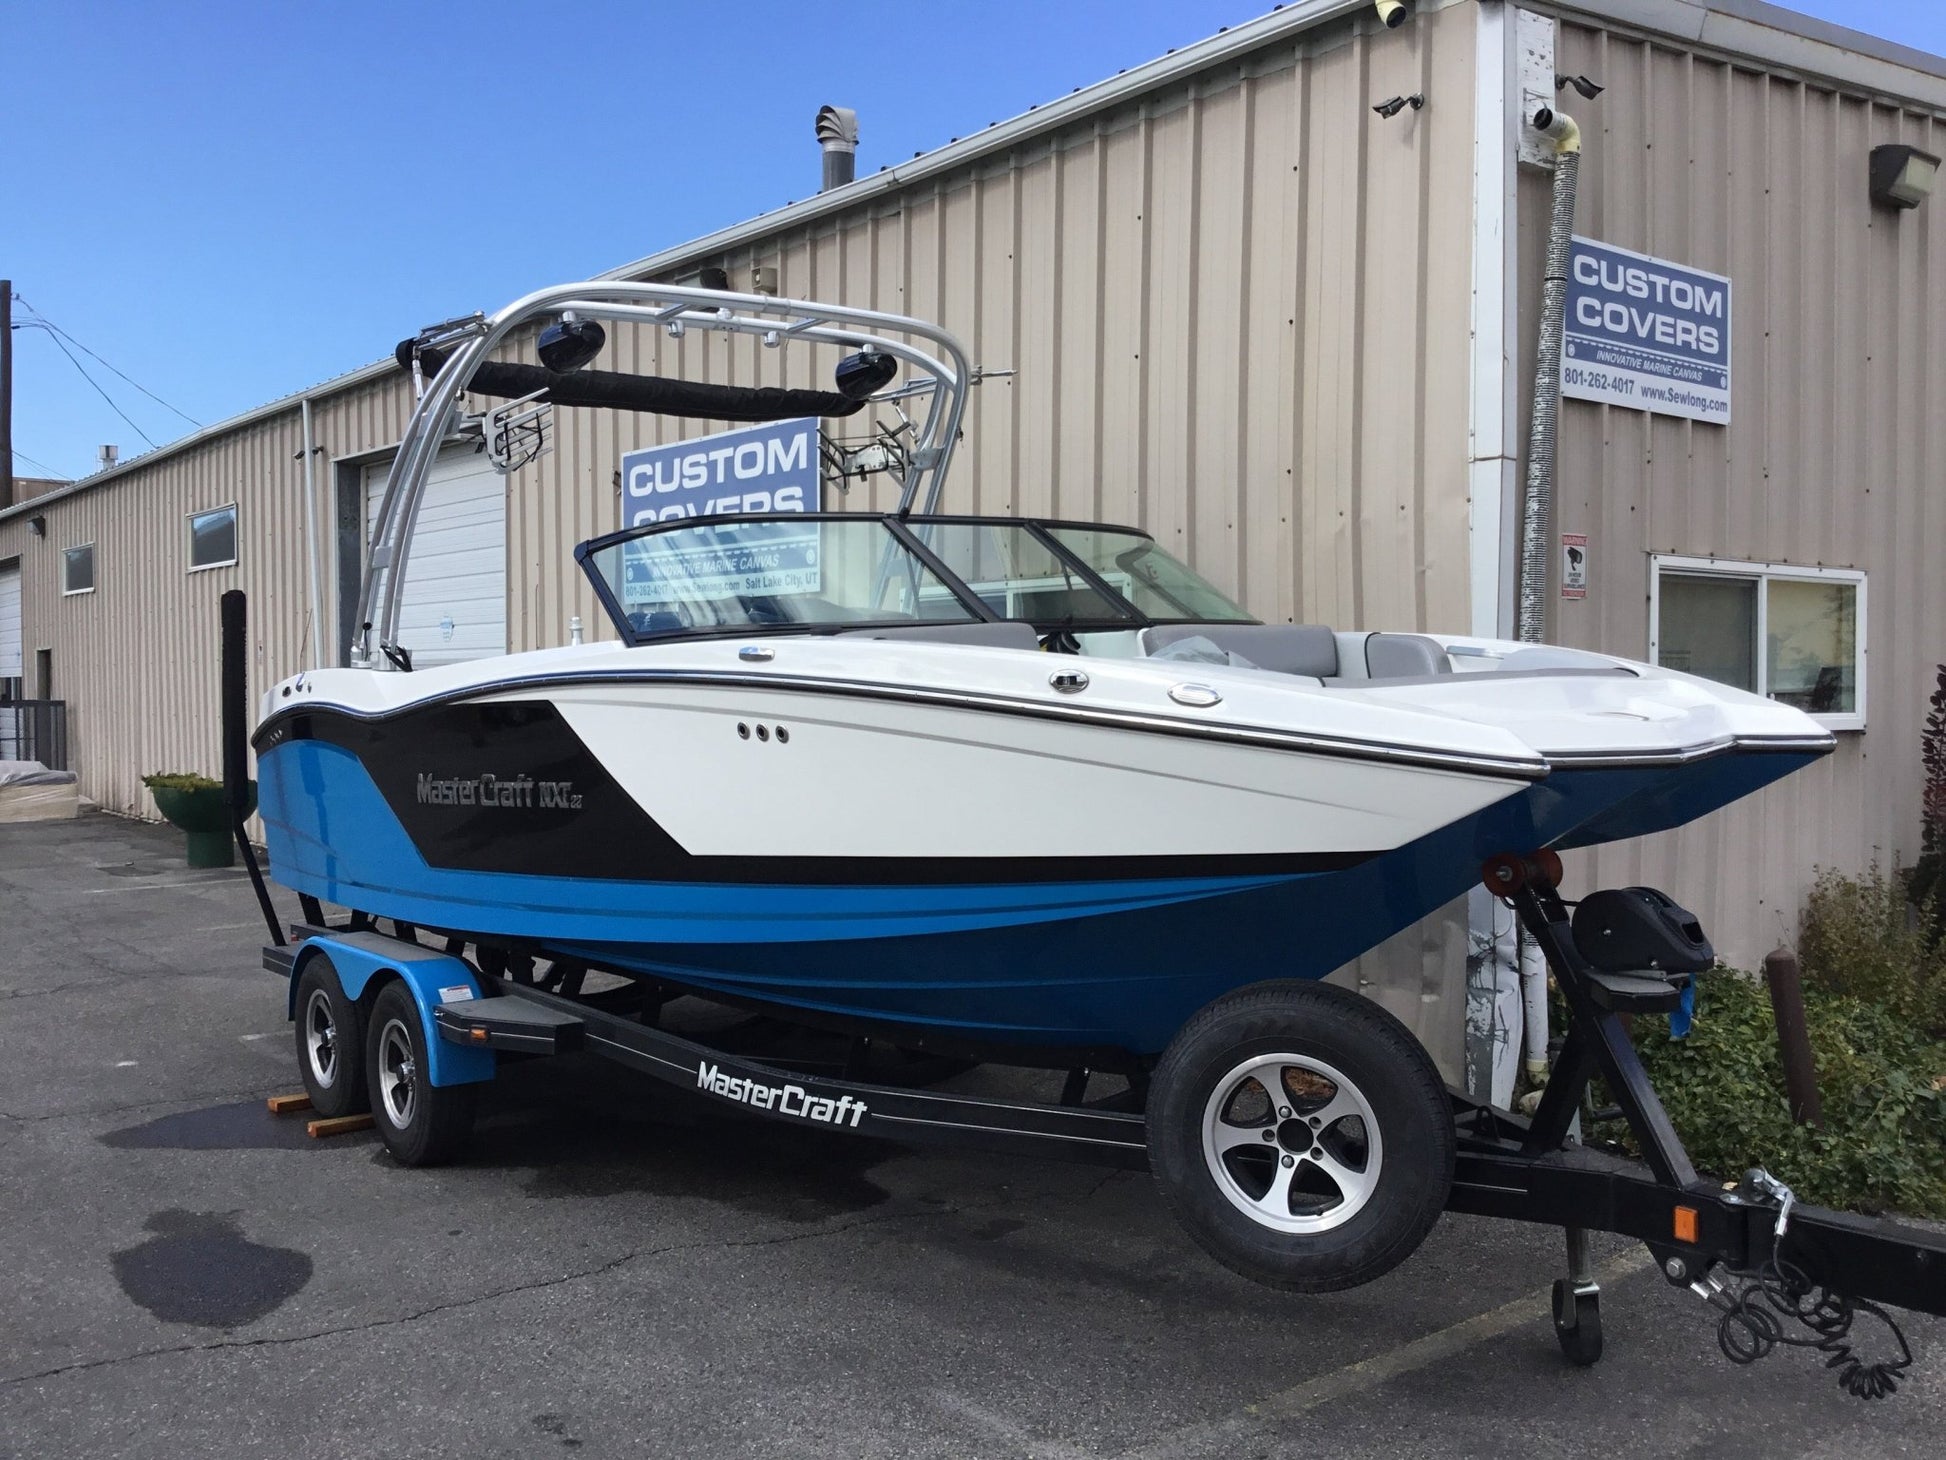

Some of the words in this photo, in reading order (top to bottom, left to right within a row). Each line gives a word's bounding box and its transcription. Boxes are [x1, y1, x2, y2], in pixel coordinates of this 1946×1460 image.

[1574, 254, 1722, 318] CUSTOM
[1576, 296, 1720, 354] COVERS
[1597, 350, 1642, 369] INNOVATIVE
[1643, 359, 1672, 375] MARINE
[1673, 366, 1703, 381] CANVAS
[1564, 367, 1635, 395] 801-262-4017
[1641, 384, 1728, 412] www.Sewlong.com
[629, 432, 808, 497] CUSTOM
[703, 558, 737, 573] MARINE
[739, 554, 780, 569] CANVAS
[745, 577, 761, 590] Salt
[763, 577, 782, 588] Lake
[805, 572, 817, 584] UT
[417, 773, 535, 808] MasterCraft
[697, 1061, 868, 1127] MasterCraft
